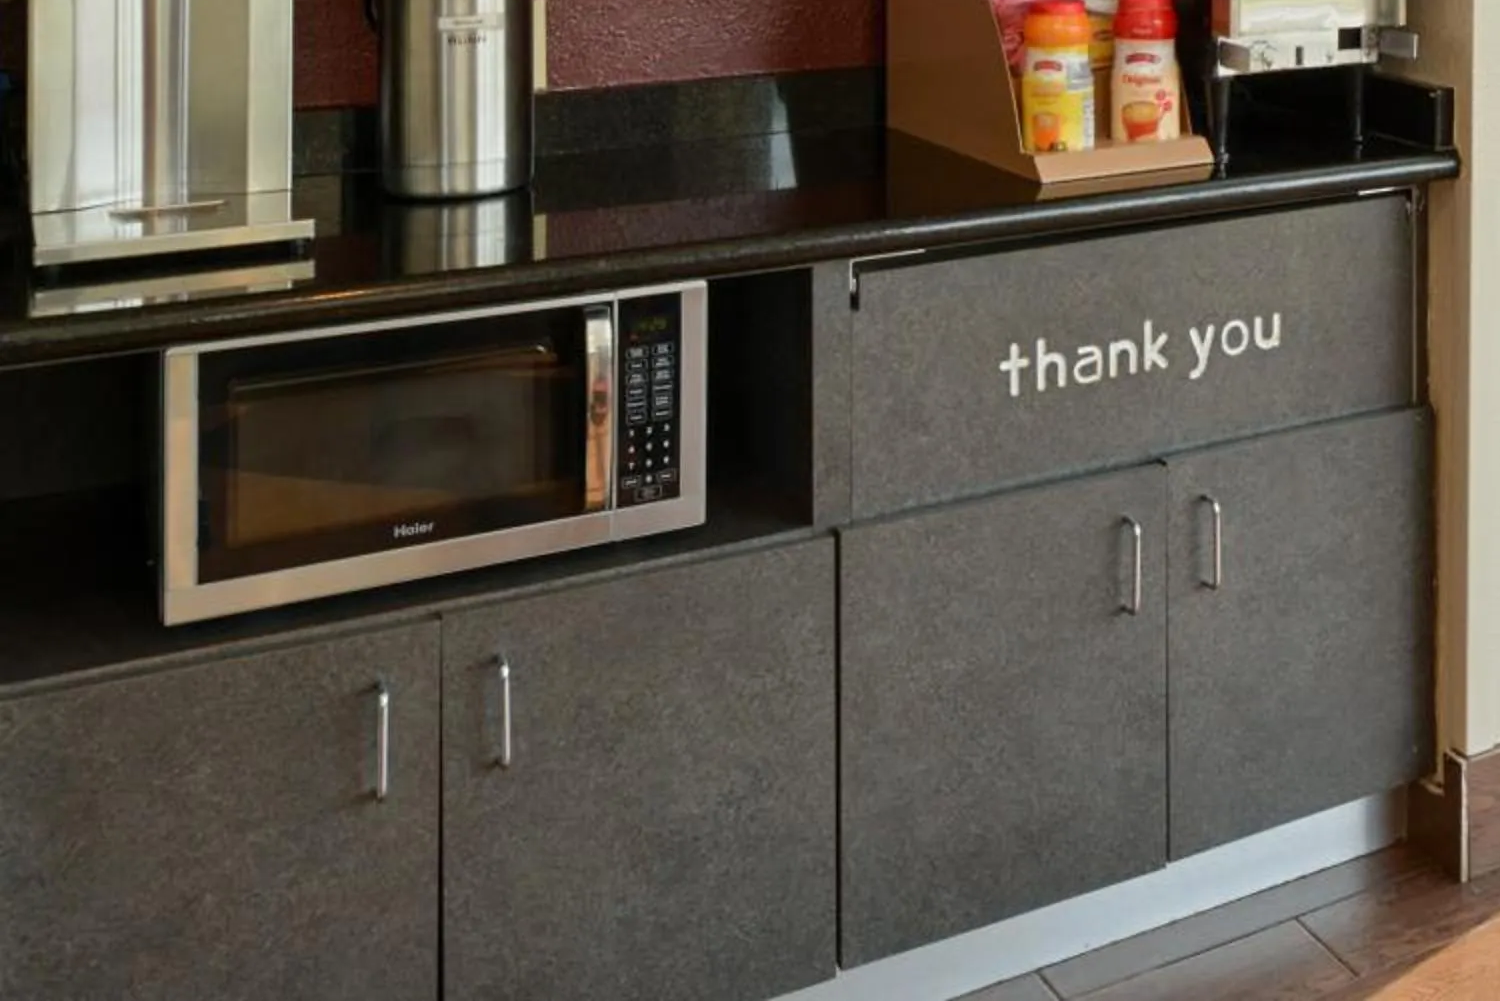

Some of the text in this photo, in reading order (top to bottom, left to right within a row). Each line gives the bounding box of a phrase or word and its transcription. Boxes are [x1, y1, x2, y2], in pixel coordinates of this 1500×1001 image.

[998, 312, 1281, 398] thank you
[393, 522, 434, 539] Haier
